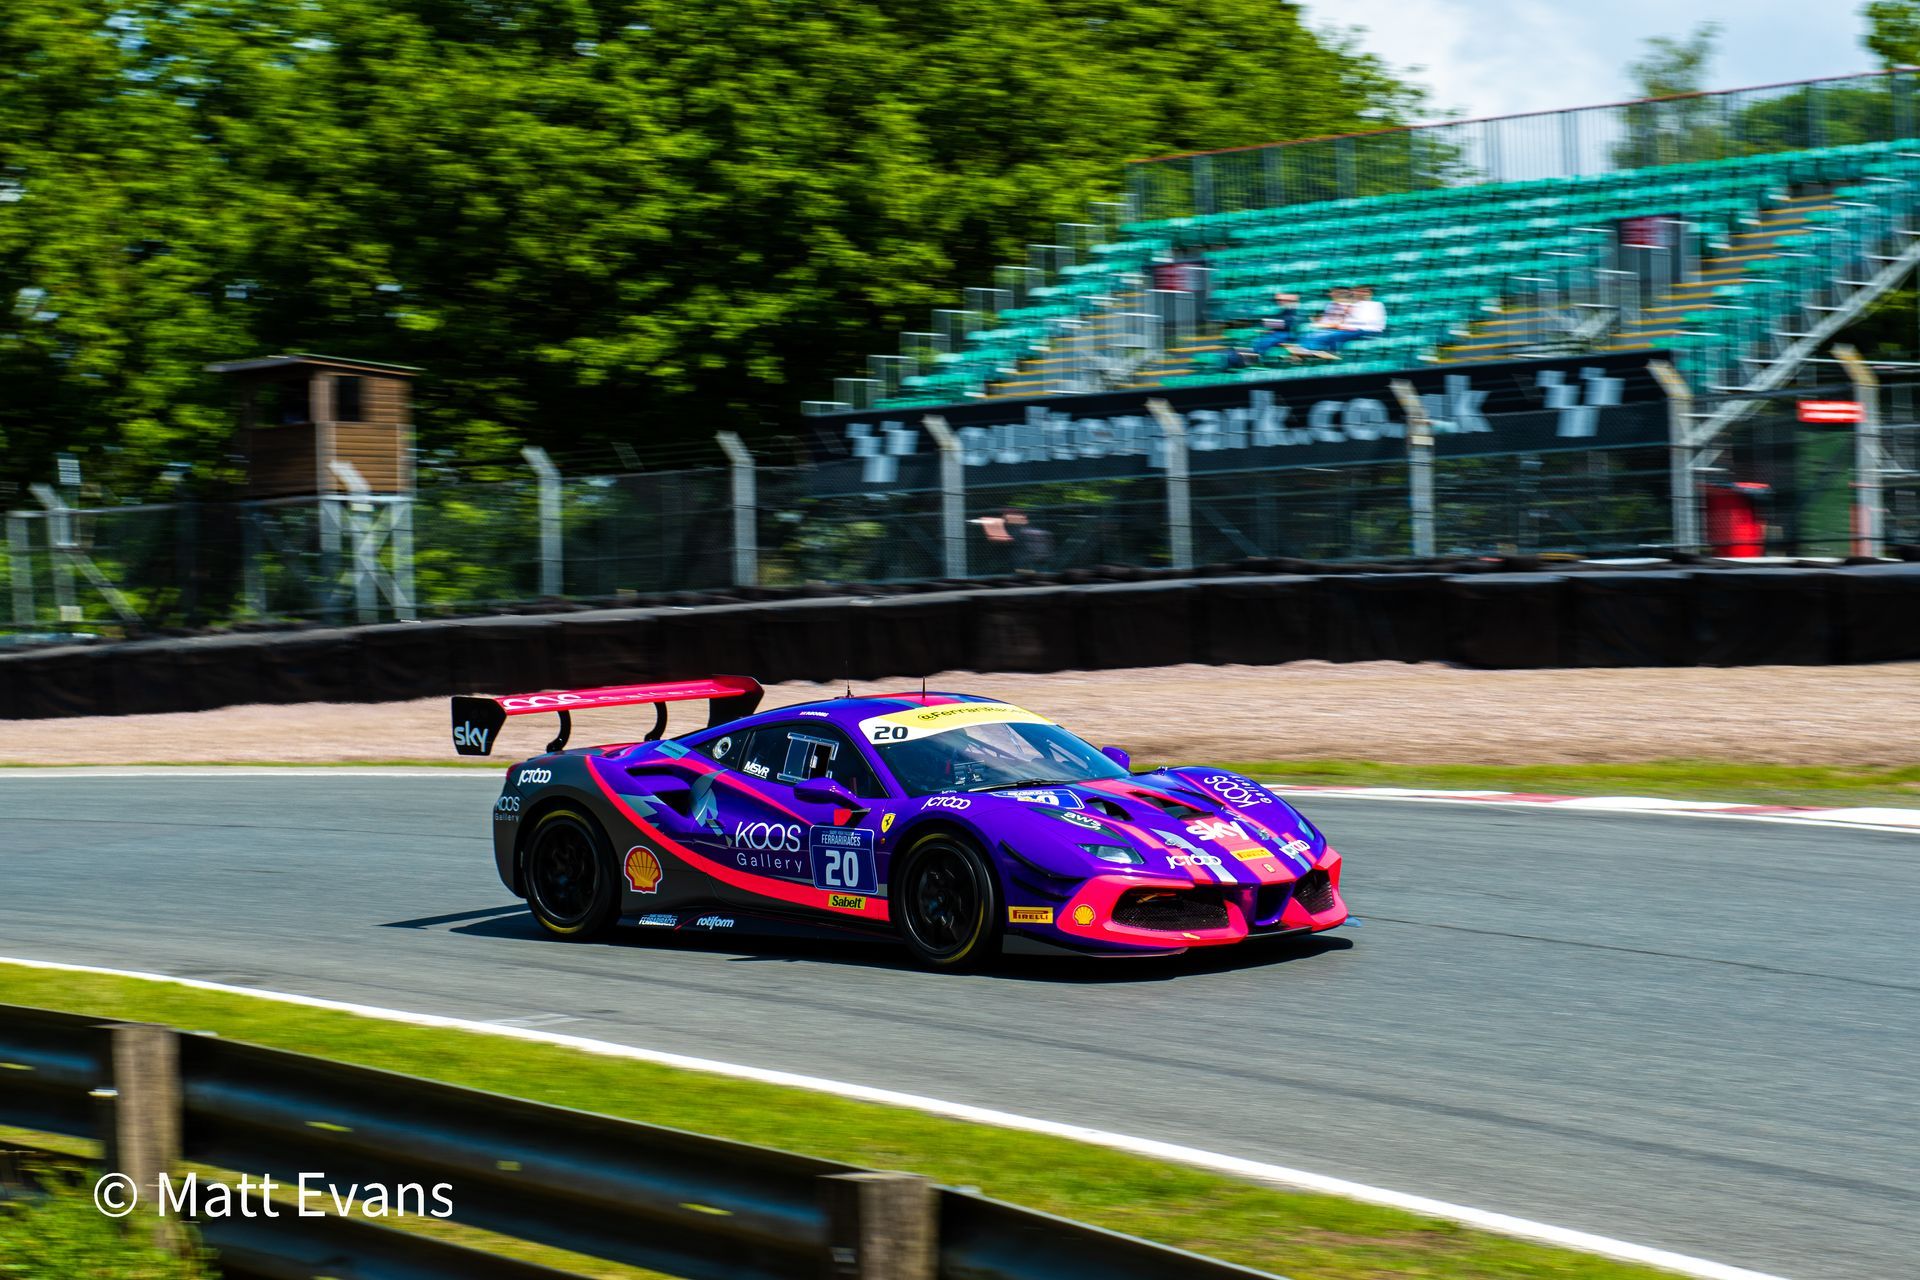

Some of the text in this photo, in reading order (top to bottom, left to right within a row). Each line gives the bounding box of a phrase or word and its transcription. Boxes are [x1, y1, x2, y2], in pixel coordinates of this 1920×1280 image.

[453, 720, 489, 753] sky
[874, 726, 909, 740] 20
[744, 761, 770, 777] MSVR
[1203, 775, 1260, 808] KOOS
[735, 821, 801, 852] KOOS
[1186, 820, 1249, 841] sky
[736, 852, 802, 873] Gallery
[825, 849, 859, 887] 20
[832, 895, 863, 909] Sabelt
[696, 916, 734, 930] rotiform
[1012, 910, 1049, 920] PIRELLI
